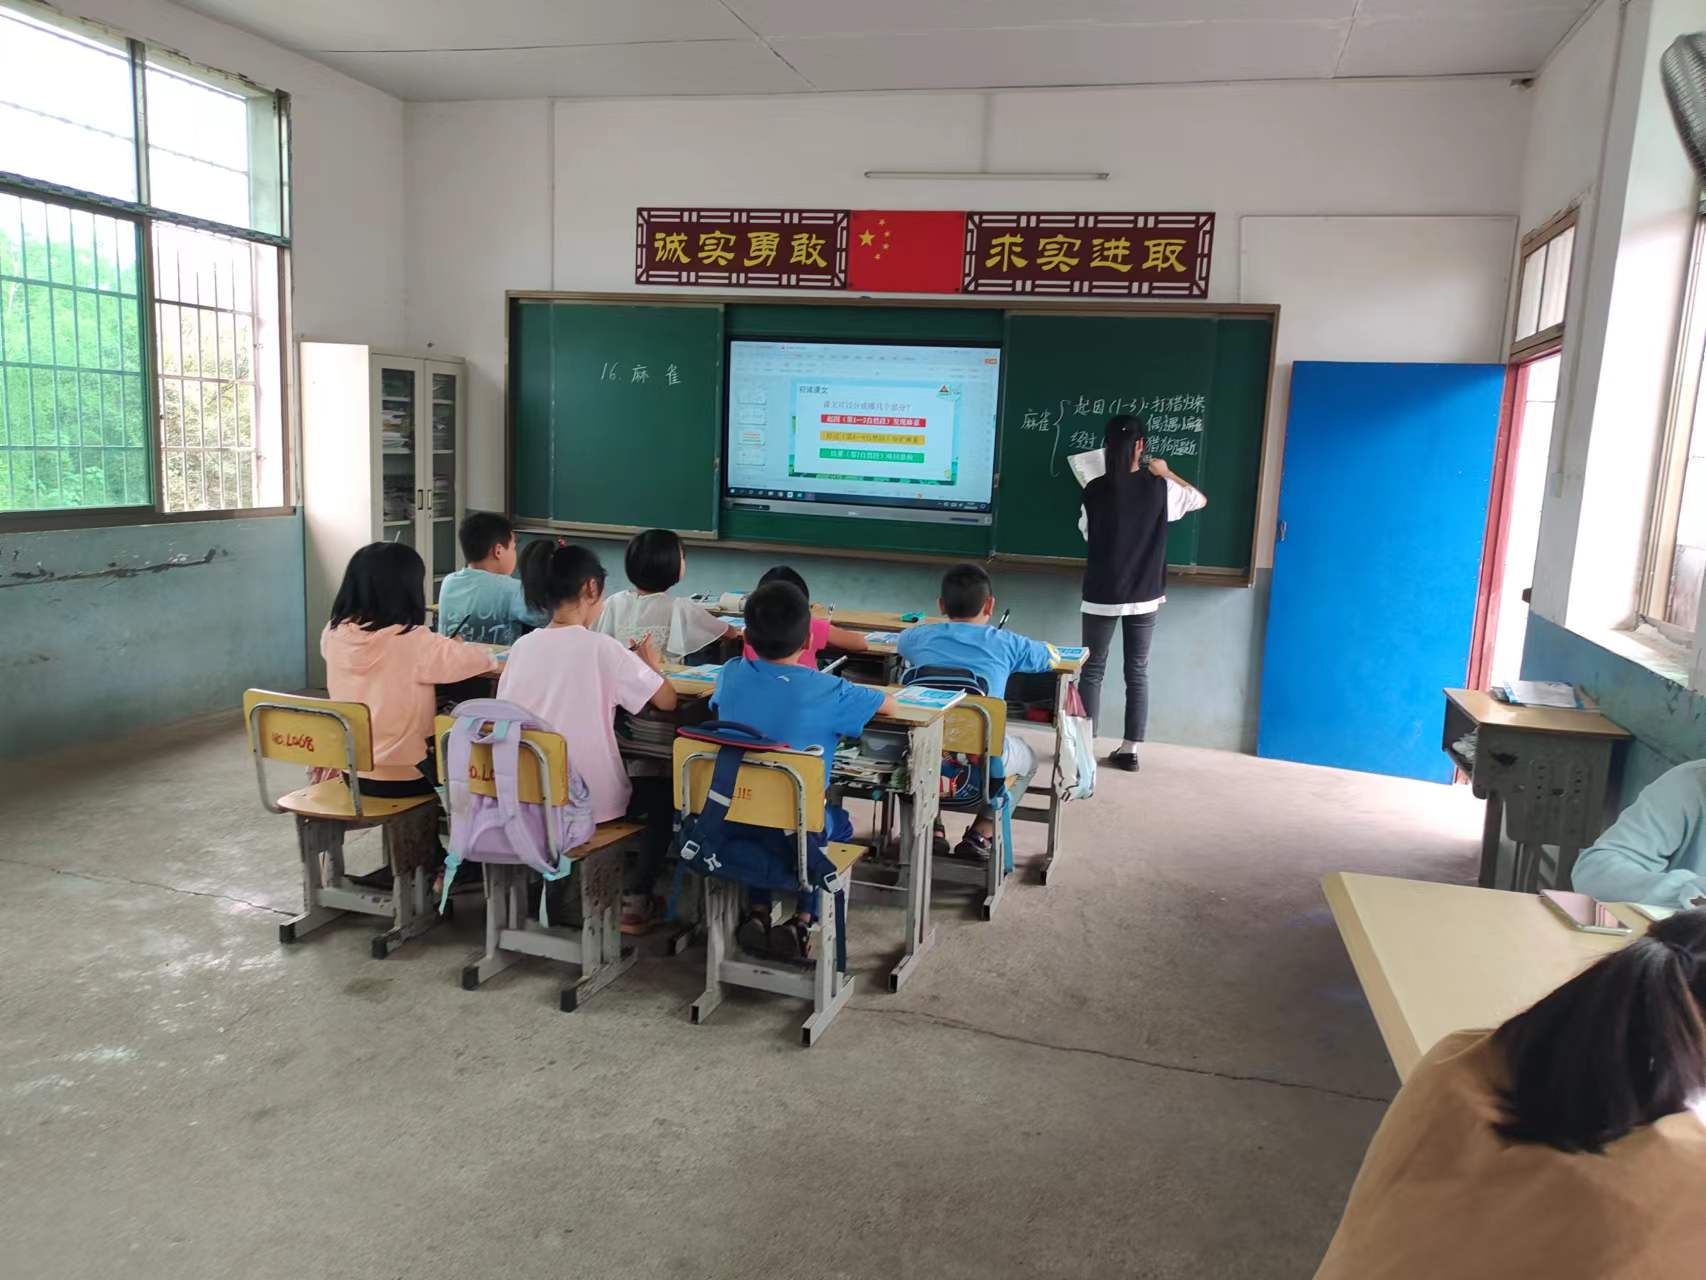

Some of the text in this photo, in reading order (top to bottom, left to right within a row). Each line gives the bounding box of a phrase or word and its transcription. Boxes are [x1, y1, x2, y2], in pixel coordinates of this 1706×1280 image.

[653, 230, 829, 269] 诚实勇敢
[984, 232, 1188, 275] 求实进取
